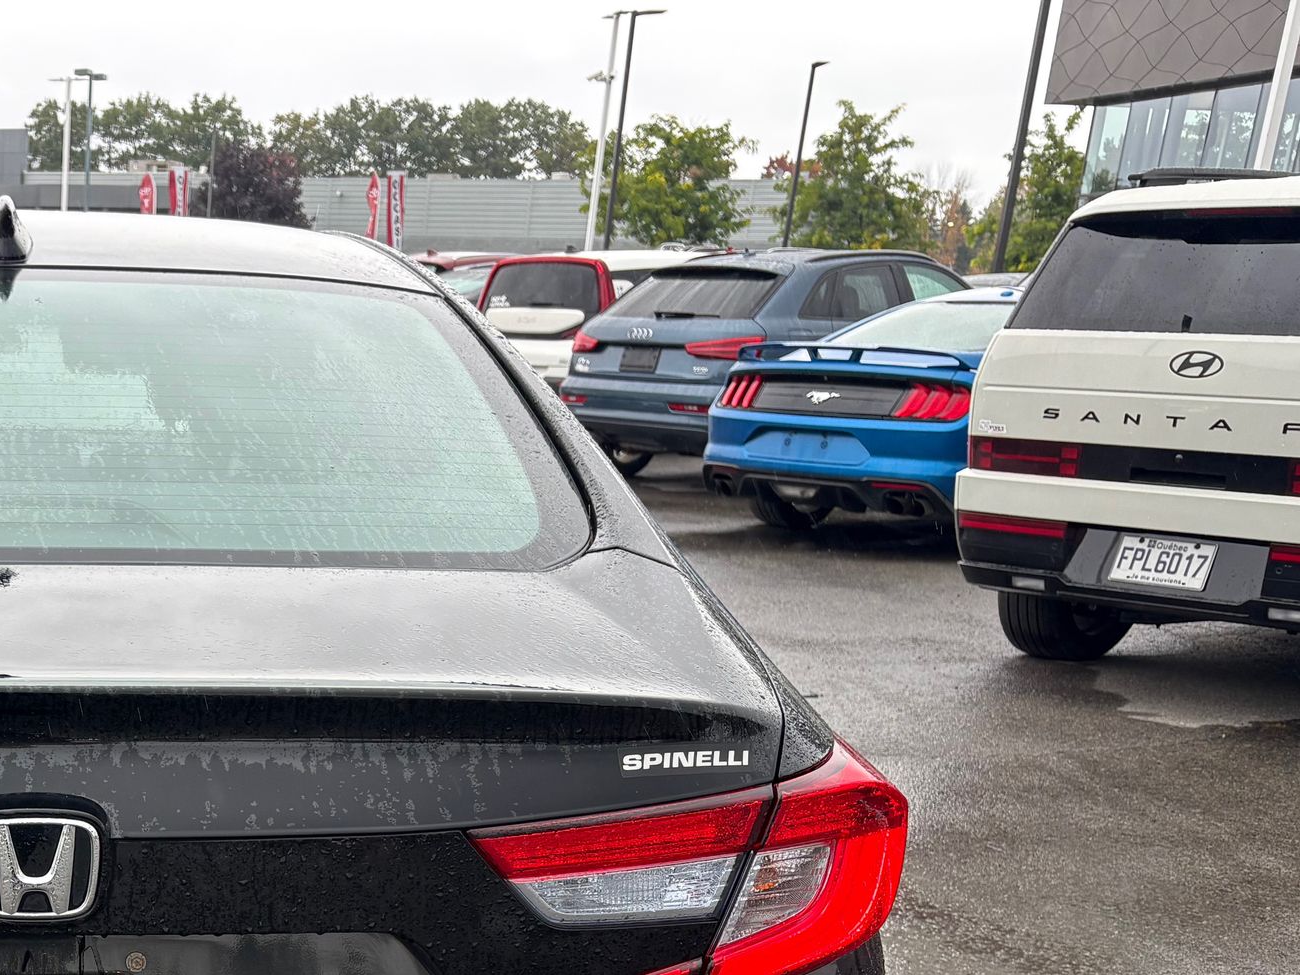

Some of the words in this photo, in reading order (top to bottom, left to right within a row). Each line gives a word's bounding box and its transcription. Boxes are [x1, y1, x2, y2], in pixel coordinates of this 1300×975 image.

[1042, 408, 1233, 432] SANTA
[1156, 541, 1189, 552] Québec
[1116, 546, 1209, 578] FPL6017
[622, 750, 750, 771] SPINELLI
